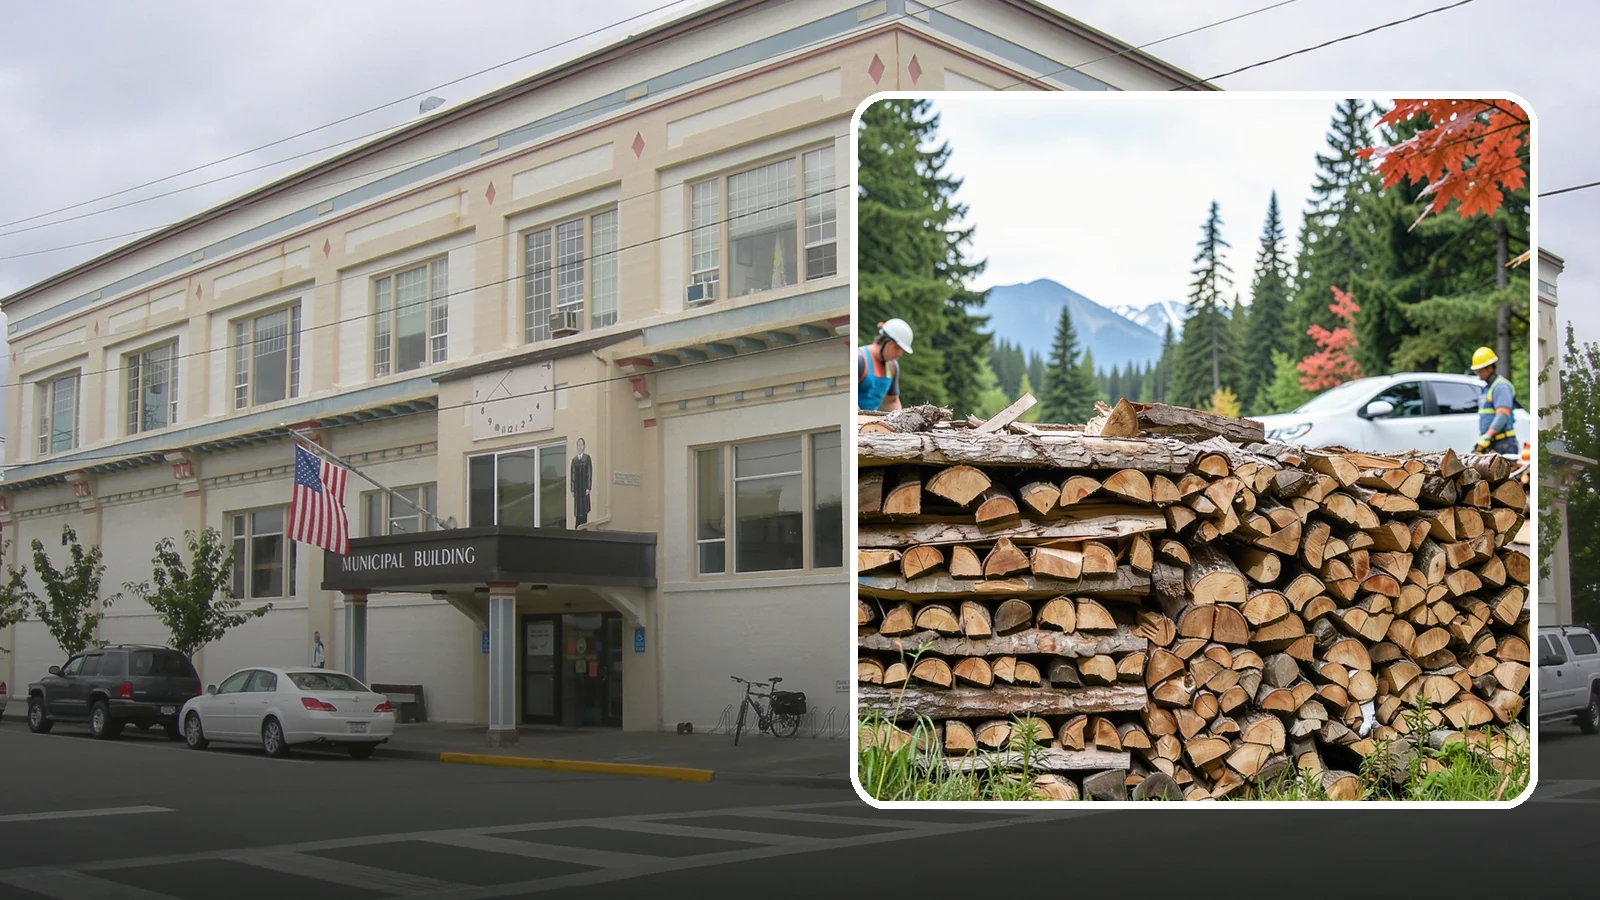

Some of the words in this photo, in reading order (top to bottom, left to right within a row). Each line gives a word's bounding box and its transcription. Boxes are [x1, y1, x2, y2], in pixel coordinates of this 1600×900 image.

[481, 406, 485, 415] 8
[488, 417, 492, 426] 9
[529, 414, 533, 422] 3
[494, 423, 500, 432] 10
[521, 420, 526, 428] 2
[507, 425, 514, 433] 12
[342, 552, 405, 572] MUNICIPAL
[414, 546, 475, 567] BUILDING
